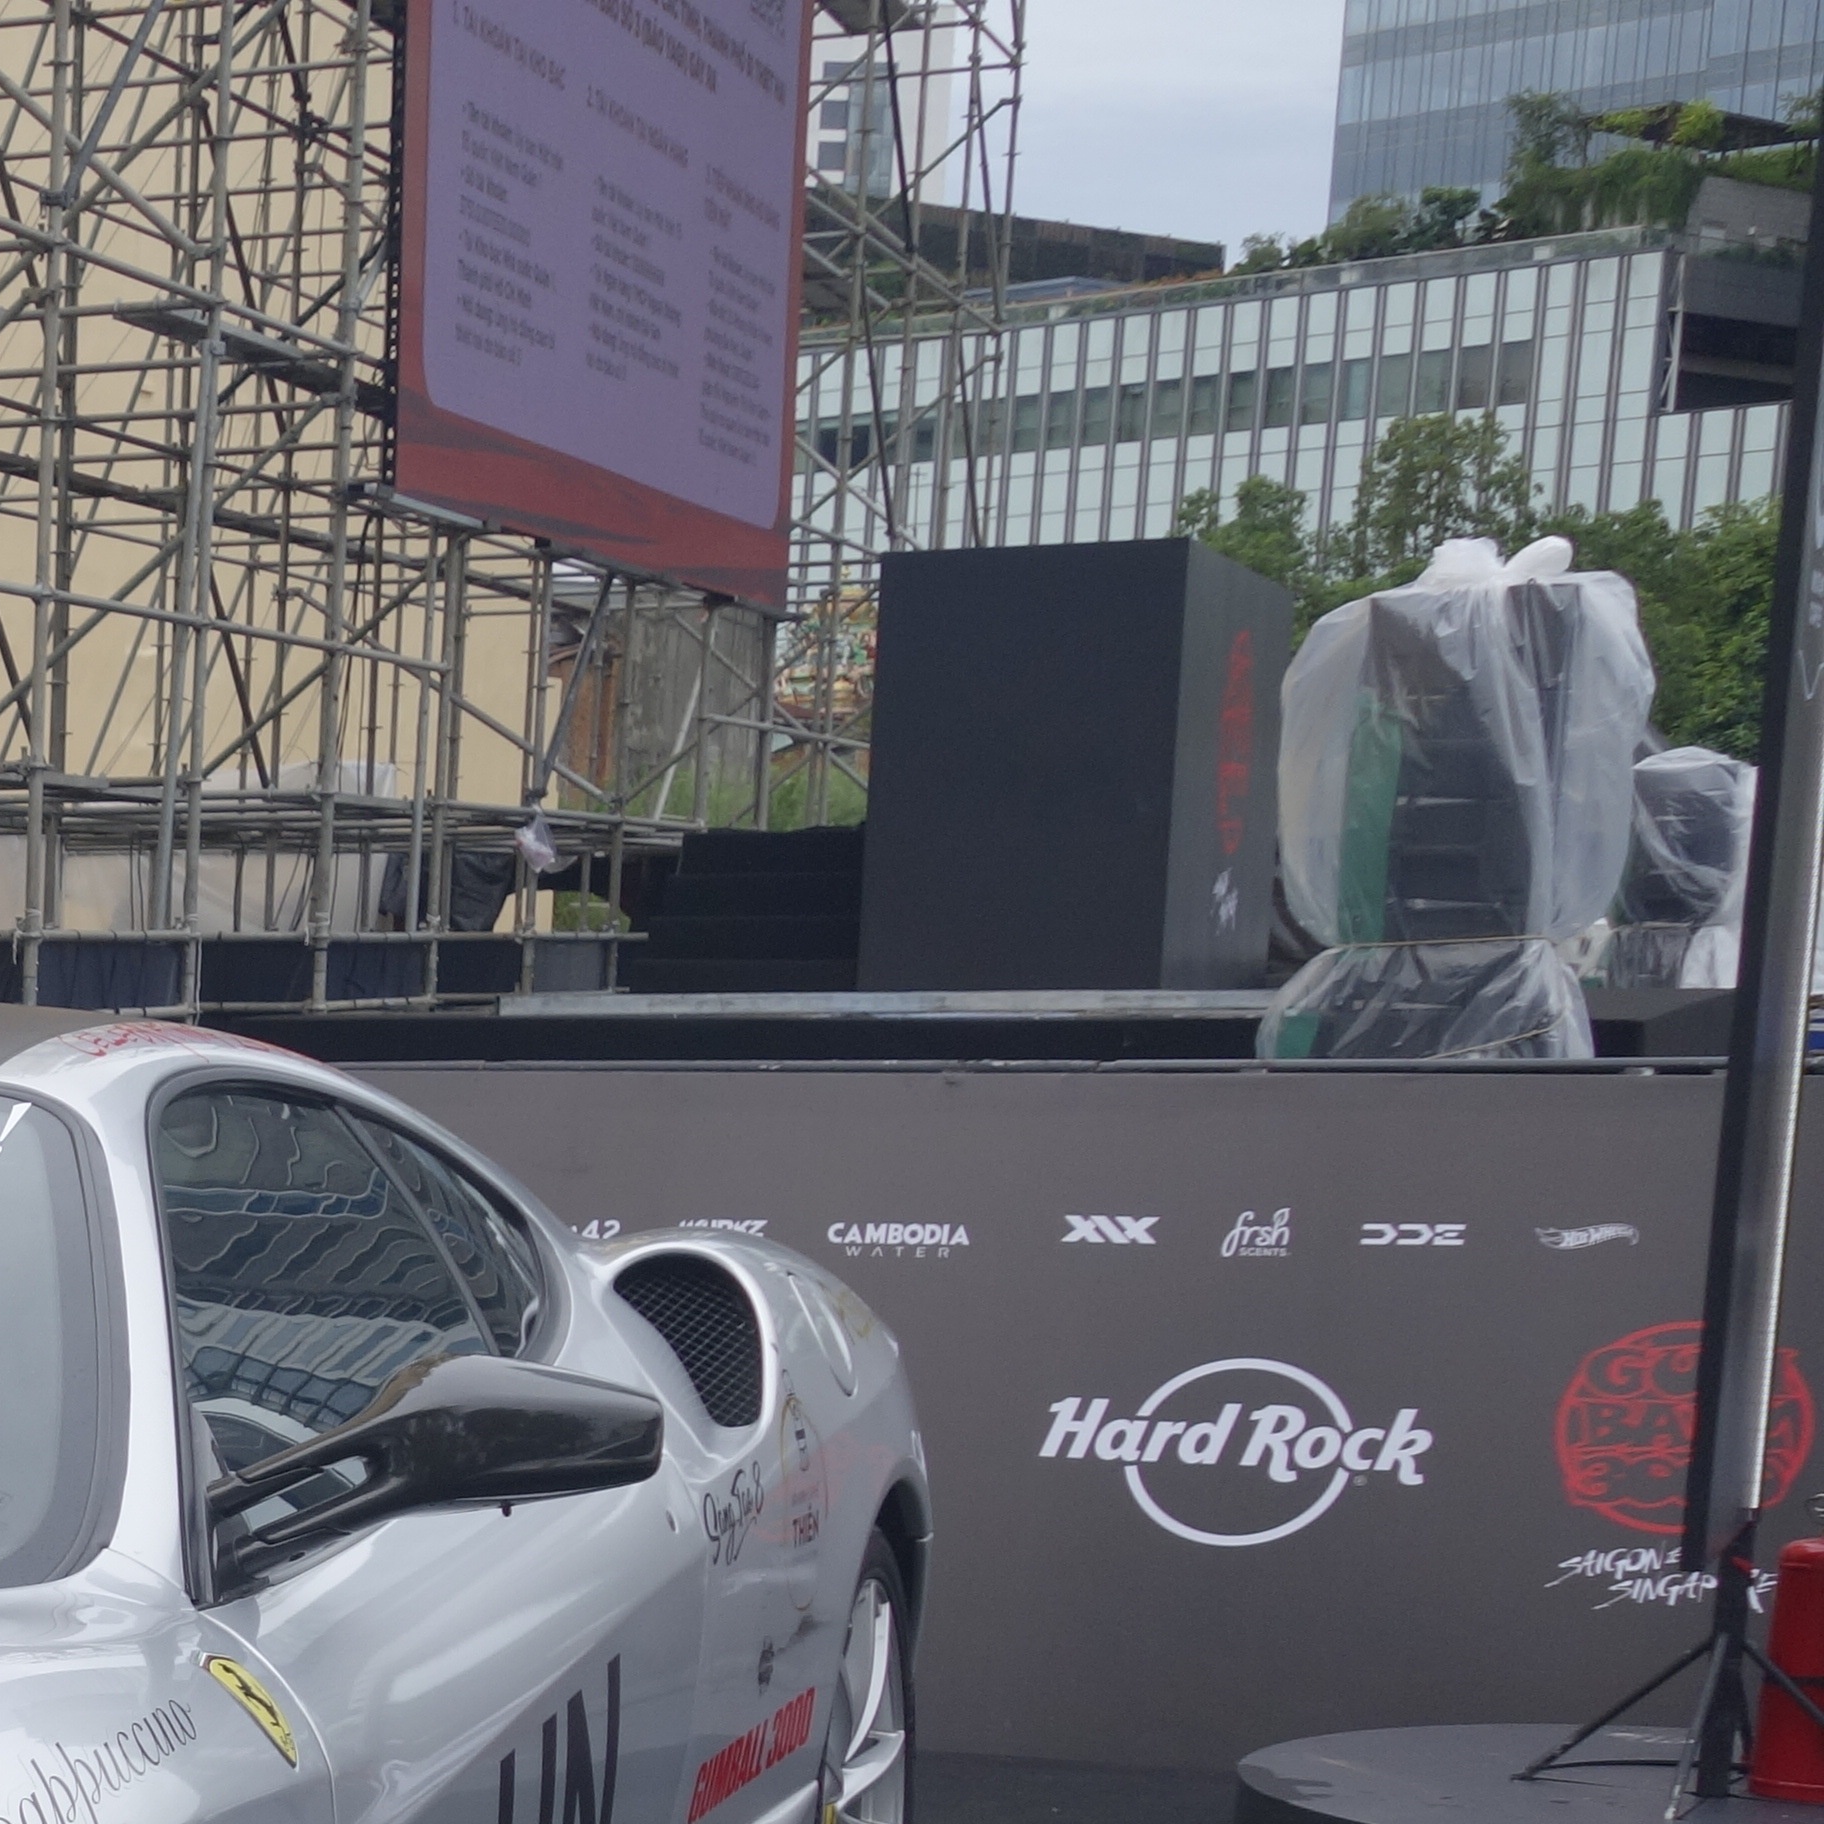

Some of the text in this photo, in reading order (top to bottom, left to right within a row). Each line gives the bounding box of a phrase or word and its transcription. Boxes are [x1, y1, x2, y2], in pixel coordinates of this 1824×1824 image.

[827, 1220, 970, 1247] CAMBODIA
[844, 1246, 950, 1259] WATER
[1221, 1206, 1292, 1258] frsh
[1238, 1247, 1289, 1257] SCENTS
[1038, 1396, 1434, 1486] Hard Rock
[1543, 1547, 1663, 1589] SAIGON
[765, 1686, 817, 1770] 3000
